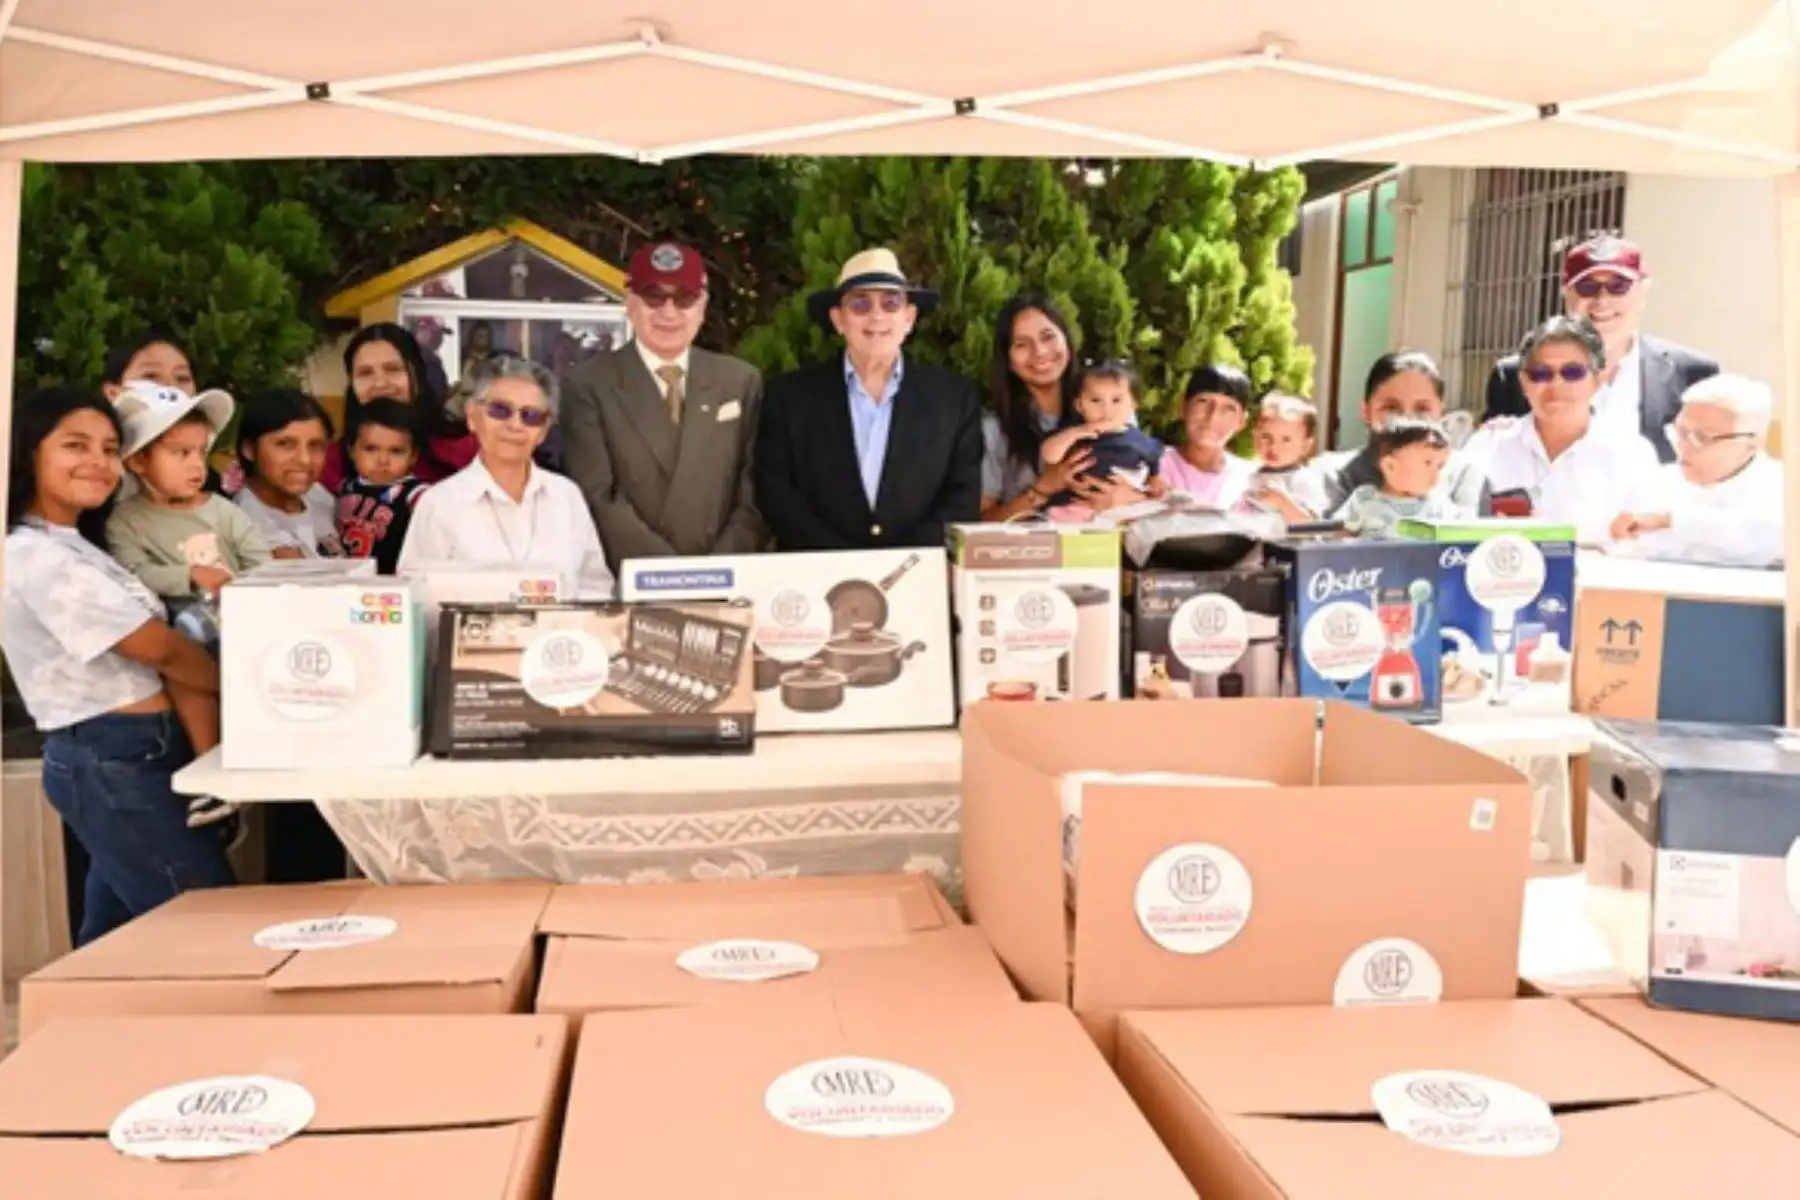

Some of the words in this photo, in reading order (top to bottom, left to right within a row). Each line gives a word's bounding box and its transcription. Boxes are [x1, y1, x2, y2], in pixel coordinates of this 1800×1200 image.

[1307, 567, 1383, 602] Oster
[820, 1068, 886, 1096] MRE
[189, 1085, 260, 1115] MRE
